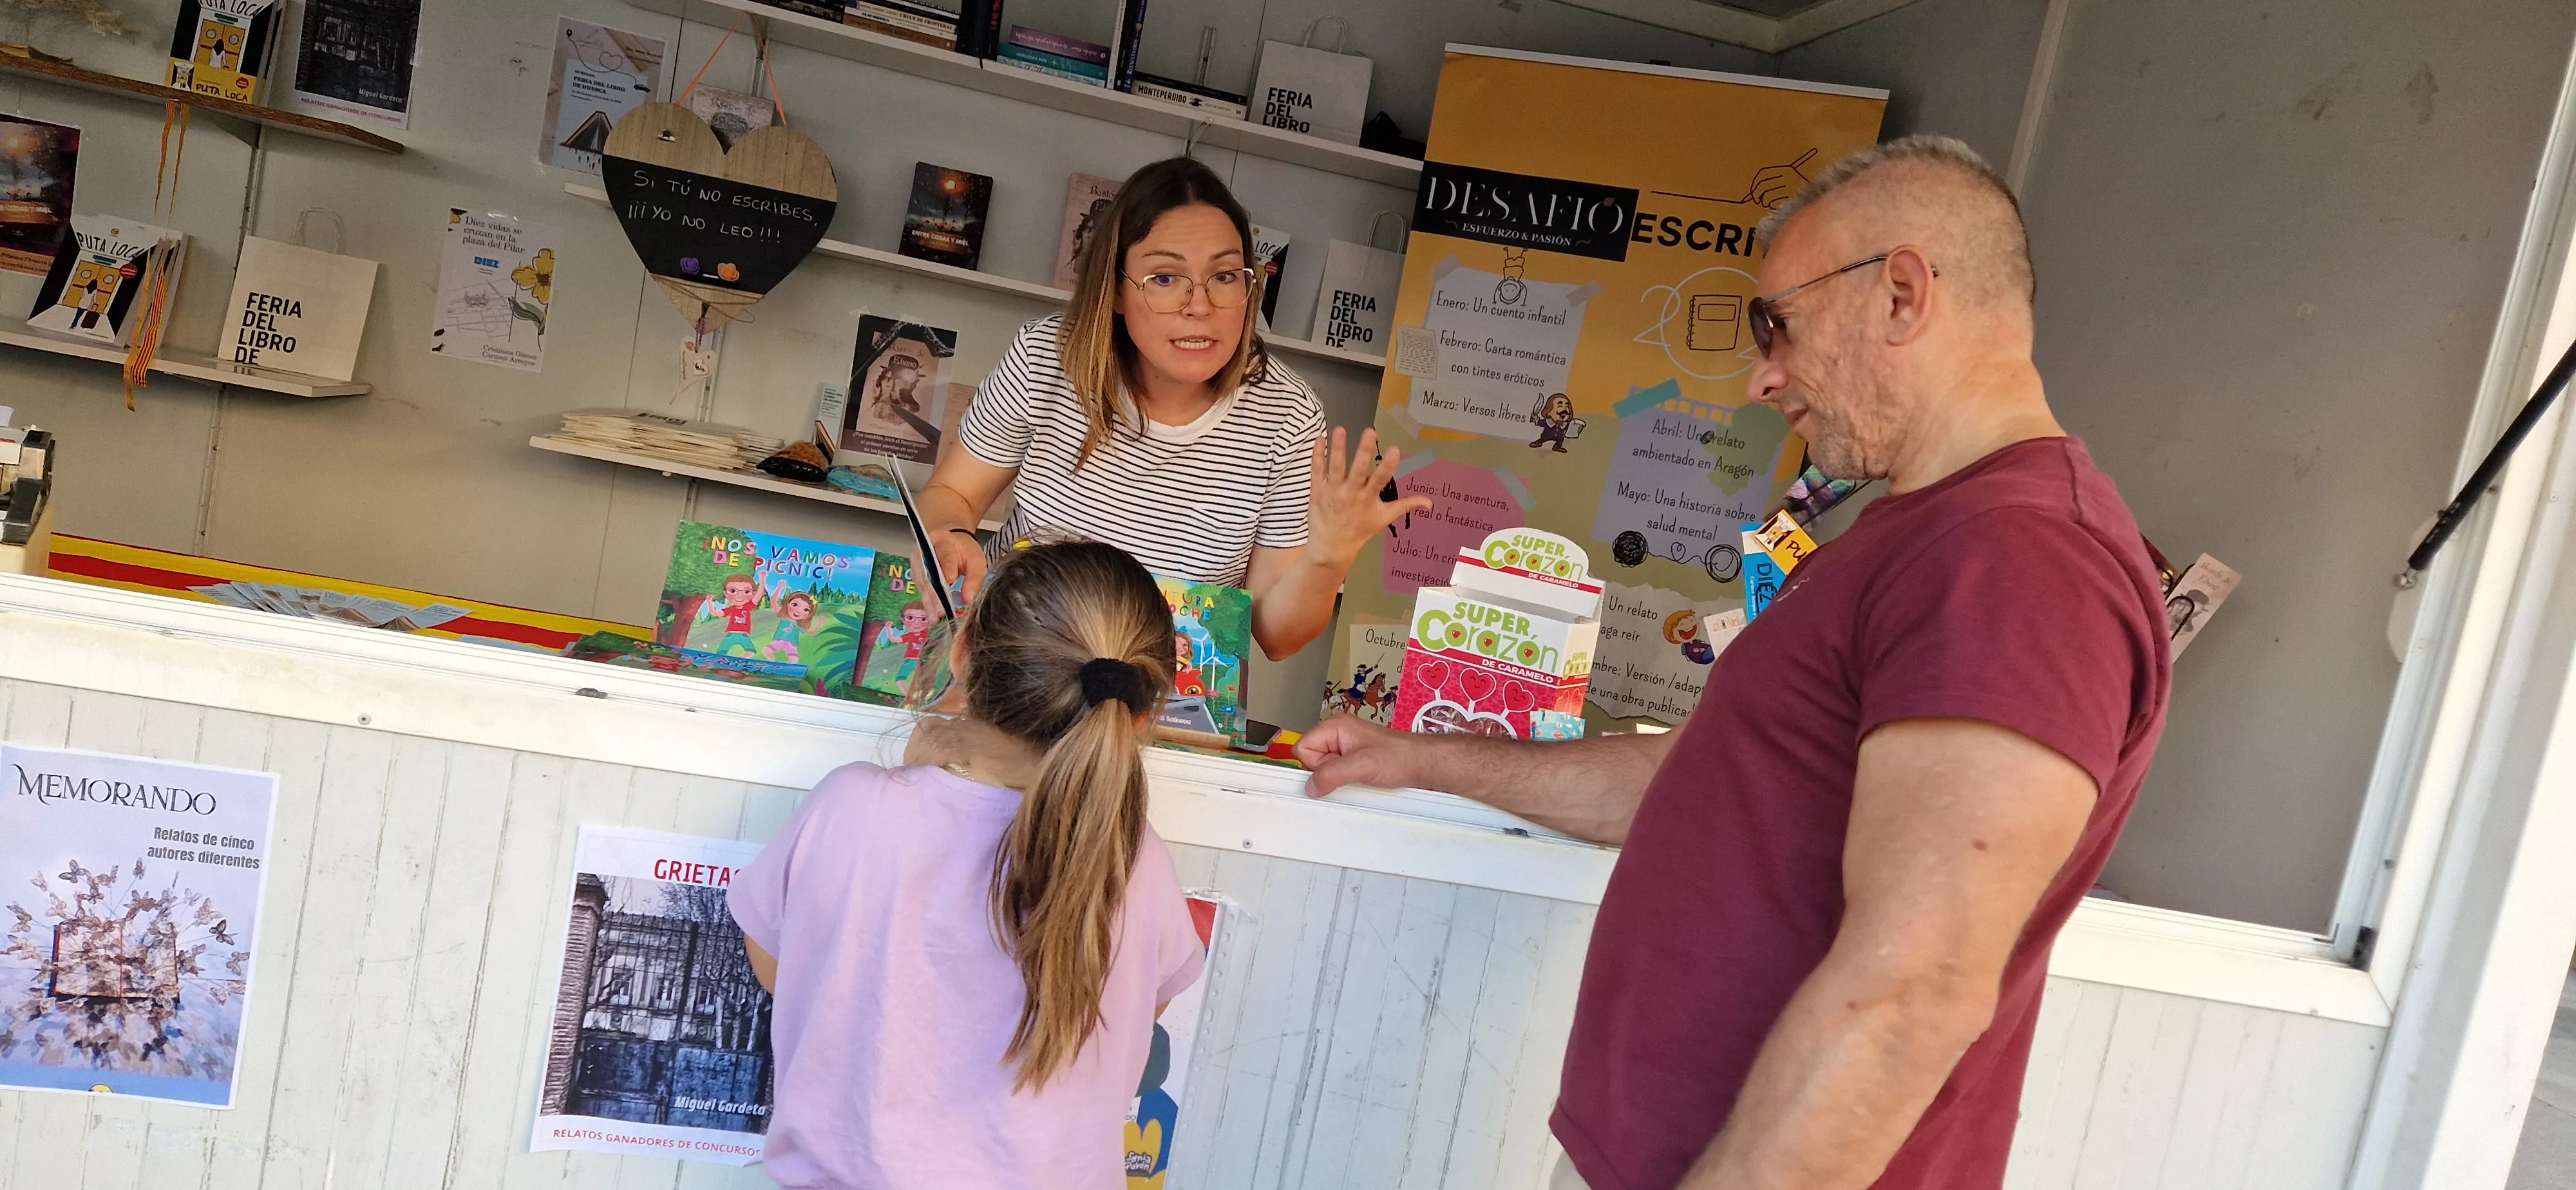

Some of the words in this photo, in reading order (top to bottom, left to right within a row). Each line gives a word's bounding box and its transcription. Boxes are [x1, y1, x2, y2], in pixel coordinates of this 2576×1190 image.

[196, 83, 220, 96] PUTA
[225, 89, 249, 102] LOCA
[359, 88, 380, 99] Miguel
[1137, 84, 1188, 104] MONTEPERDIDO
[1267, 87, 1313, 109] FERIA
[1264, 102, 1294, 118] DEL
[1262, 117, 1311, 134] LIBRO
[667, 179, 690, 195] TÚ
[699, 188, 721, 202] NO
[465, 216, 486, 228] Diez
[488, 222, 511, 232] vidas
[683, 215, 705, 230] NO
[75, 231, 106, 252] PUTA
[109, 241, 146, 259] LOCA
[462, 235, 486, 246] plaza
[488, 240, 501, 249] del
[504, 241, 526, 254] Pilar
[463, 227, 493, 239] cruzan
[508, 234, 516, 243] la
[911, 229, 931, 240] ENTRE
[931, 232, 951, 243] COSAS
[1463, 222, 1520, 240] ESFUERZO
[1531, 233, 1572, 247] PASIÓN
[1631, 212, 1766, 259] ESCRI
[1255, 240, 1282, 258] LOCA
[474, 256, 500, 269] DIEZ
[246, 292, 301, 318] FERIA
[1332, 290, 1376, 312] FERIA
[1436, 290, 1470, 312] Enero:
[1473, 297, 1488, 314] Un
[1491, 305, 1525, 320] cuento
[1528, 305, 1567, 326] infantil
[242, 310, 278, 332] DEL
[1330, 305, 1358, 325] DEL
[238, 328, 297, 353] LIBRO
[1327, 321, 1373, 343] LIBRO
[234, 346, 260, 366] DE
[1440, 330, 1481, 352] Febrero:
[1485, 338, 1512, 356] Carta
[1515, 350, 1566, 366] romántica
[1451, 364, 1469, 375] con
[1472, 365, 1501, 381] tintes
[1504, 372, 1545, 388] eróticos
[1422, 390, 1458, 411] Marzo:
[1463, 397, 1495, 418] Versos
[1499, 402, 1526, 424] libres
[1652, 419, 1683, 439] Abril:
[1687, 424, 1703, 440] Un
[1711, 429, 1745, 449] relato
[1633, 442, 1694, 466] ambientado
[1698, 460, 1711, 469] en
[1714, 456, 1754, 478] Aragón
[1406, 477, 1438, 496] Junio:
[1442, 483, 1461, 500] Una
[1464, 492, 1509, 512] aventura,
[1617, 481, 1651, 504] Mayo:
[1655, 488, 1676, 507] Una
[1679, 491, 1721, 516] historia
[1725, 503, 1756, 522] sobre
[1414, 504, 1435, 519] real
[1436, 513, 1442, 521] o
[1446, 507, 1493, 532] fantástica
[1647, 514, 1677, 533] salud
[1679, 525, 1718, 541] mental
[1393, 539, 1421, 558] Julio:
[1425, 545, 1439, 561] Un
[1511, 534, 1566, 557] SUPER
[1785, 540, 1807, 562] PU
[713, 551, 740, 567] DE
[753, 556, 834, 581] PICNIC!
[771, 545, 851, 570] VAMOS
[1484, 540, 1584, 581] Corazón
[891, 578, 916, 595] DE
[1391, 567, 1450, 587] investigació
[1528, 572, 1539, 580] DE
[1539, 575, 1579, 589] CARAMELO
[1164, 589, 1215, 609] TURA
[1609, 595, 1624, 612] Un
[1627, 601, 1658, 621] relato
[1168, 603, 1212, 621] OCHE
[1452, 601, 1531, 637] SUPER
[1417, 609, 1559, 674] Corazón
[1600, 625, 1618, 639] aga
[1621, 630, 1641, 642] reír
[1481, 658, 1496, 668] DE
[1497, 663, 1555, 683] CARAMELO
[1591, 656, 1621, 676] mbre:
[1627, 662, 1665, 686] Versión
[1668, 672, 1705, 698] /adap
[1599, 689, 1618, 701] una
[1621, 688, 1645, 707] obra
[11, 763, 217, 816] MEMORANDO
[153, 827, 200, 844] Relatos
[202, 833, 218, 845] de
[221, 835, 255, 850] cinco
[147, 845, 194, 862] autores
[198, 850, 260, 870] diferentes
[654, 858, 741, 888] GRIETA
[674, 1095, 717, 1111] Miguel
[553, 1129, 603, 1141] RELATOS
[606, 1133, 675, 1148] GANADORES
[678, 1140, 692, 1149] DE
